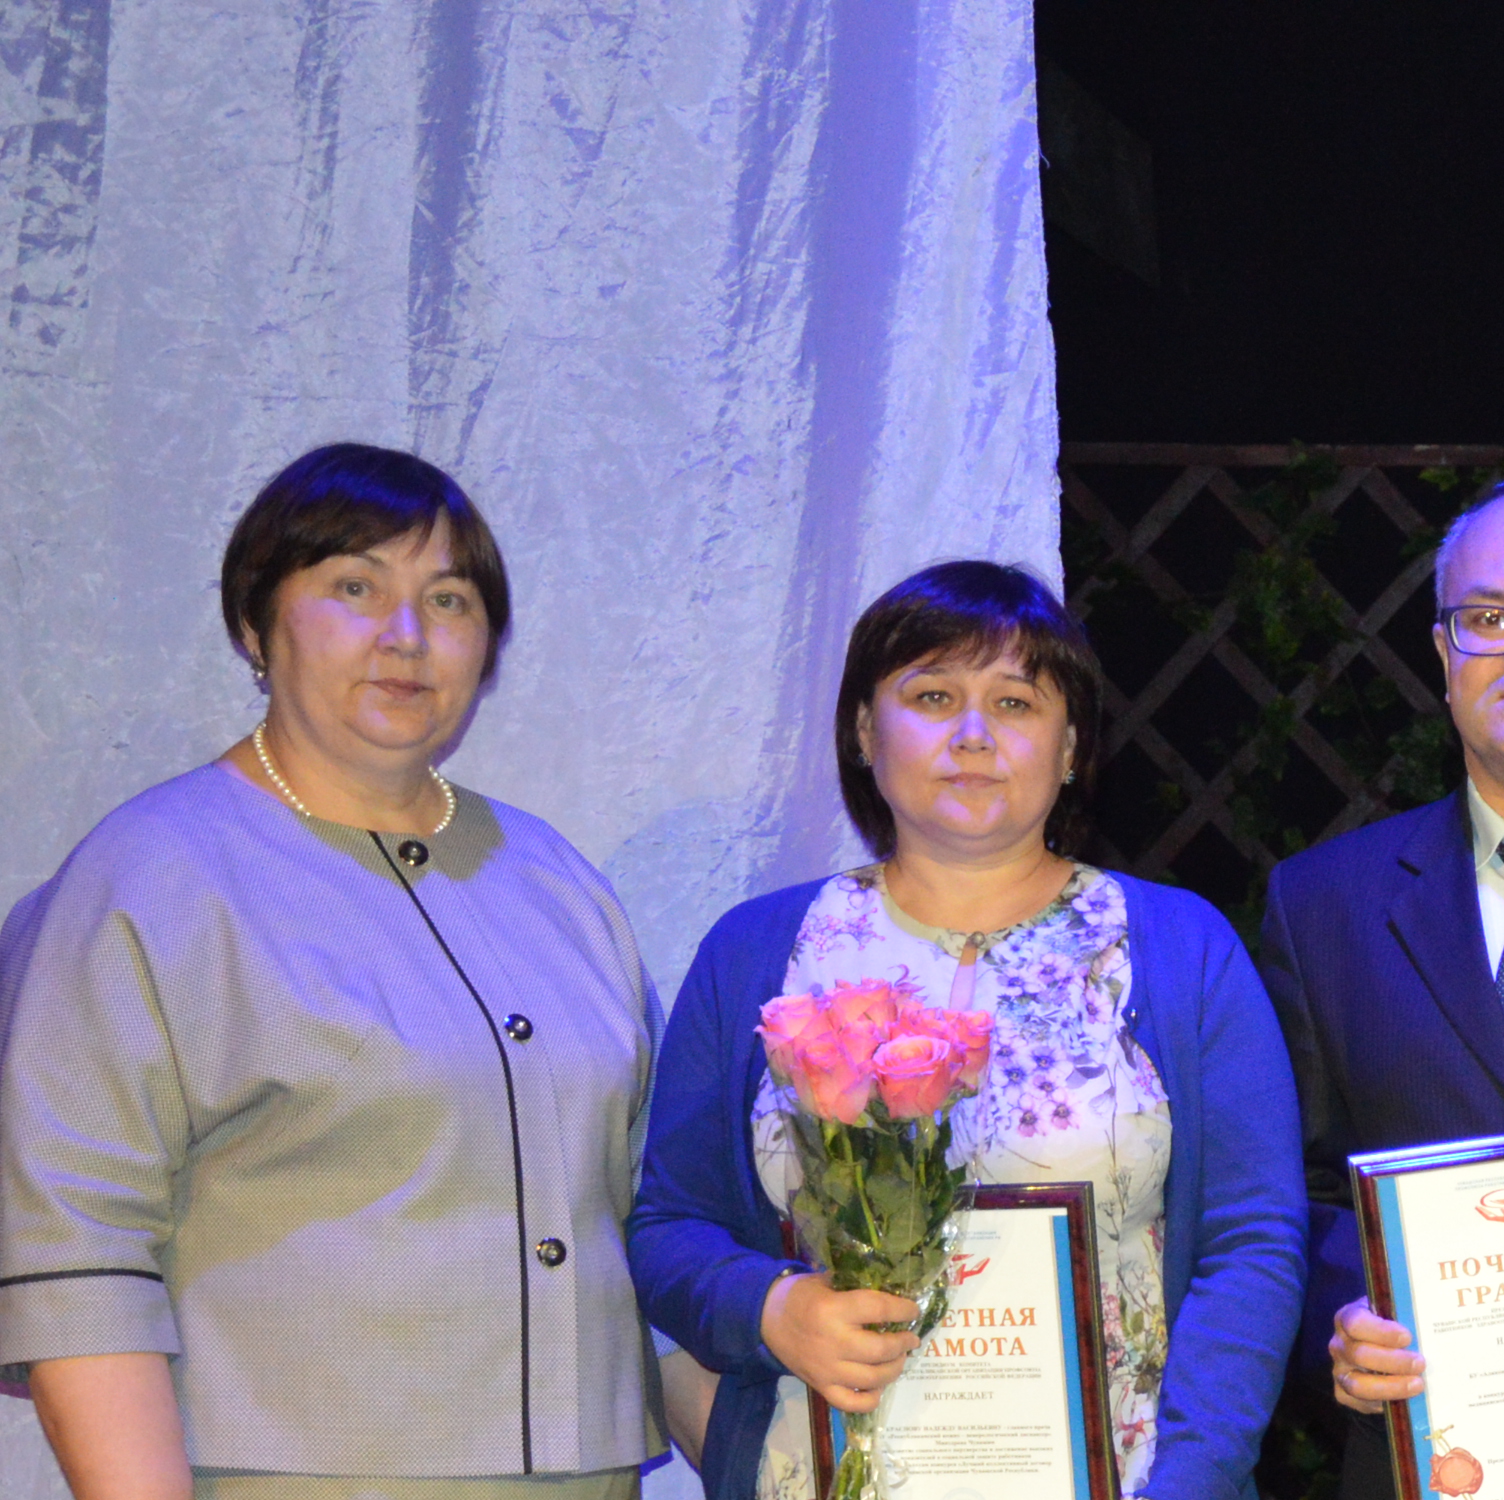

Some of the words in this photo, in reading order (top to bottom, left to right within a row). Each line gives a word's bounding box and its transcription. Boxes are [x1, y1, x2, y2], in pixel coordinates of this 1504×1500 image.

[941, 1307, 1036, 1327] ЕТНАЯ
[923, 1336, 1027, 1357] АМОТА
[924, 1391, 994, 1401] НАГРАЖДАЕТ
